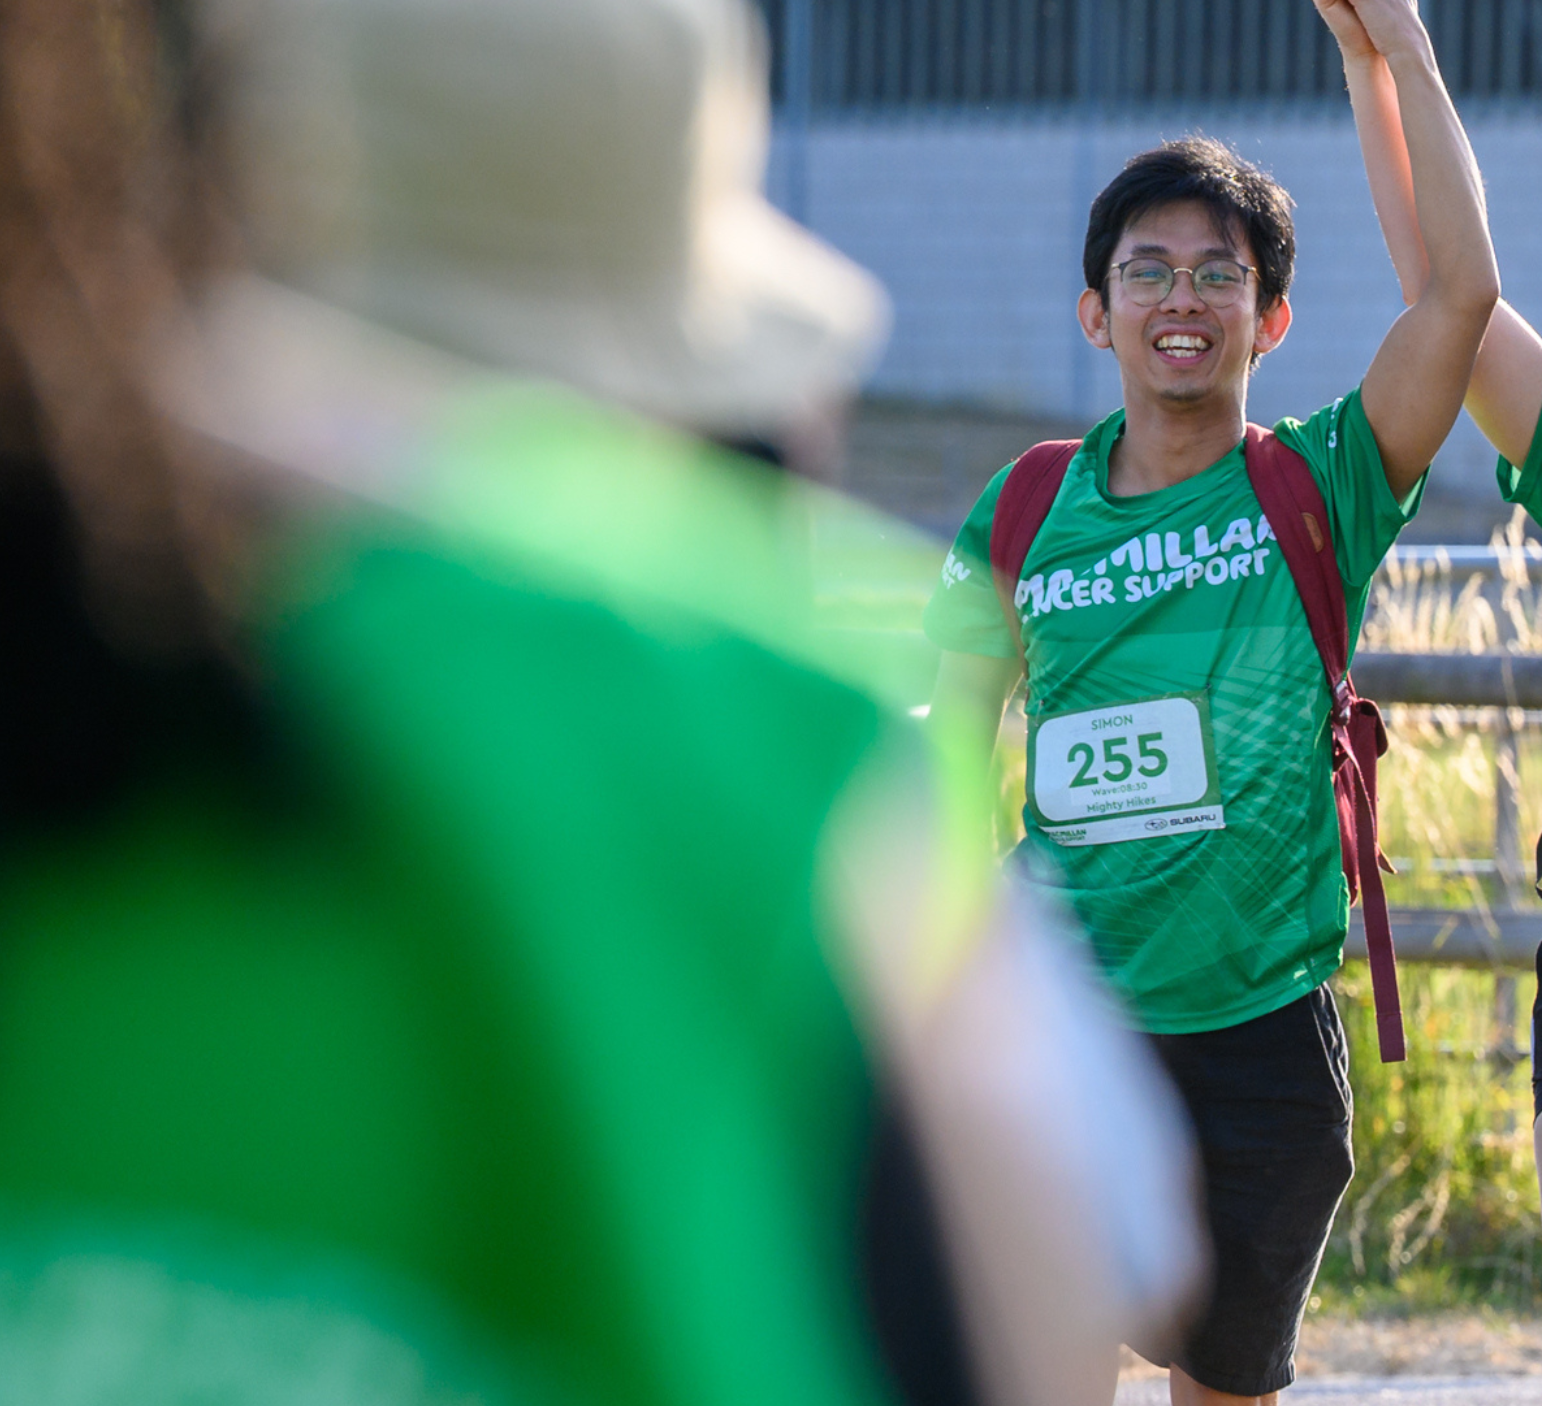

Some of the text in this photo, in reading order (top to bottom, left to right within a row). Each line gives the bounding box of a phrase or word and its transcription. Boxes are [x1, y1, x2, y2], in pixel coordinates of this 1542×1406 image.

[1124, 548, 1270, 602] SUPPORT
[1091, 715, 1133, 731] SIMON
[1067, 732, 1168, 788] 255
[1091, 782, 1148, 797] Wave:08:30
[1087, 796, 1157, 813] Mighty Hikes
[1170, 813, 1216, 826] SUBARU
